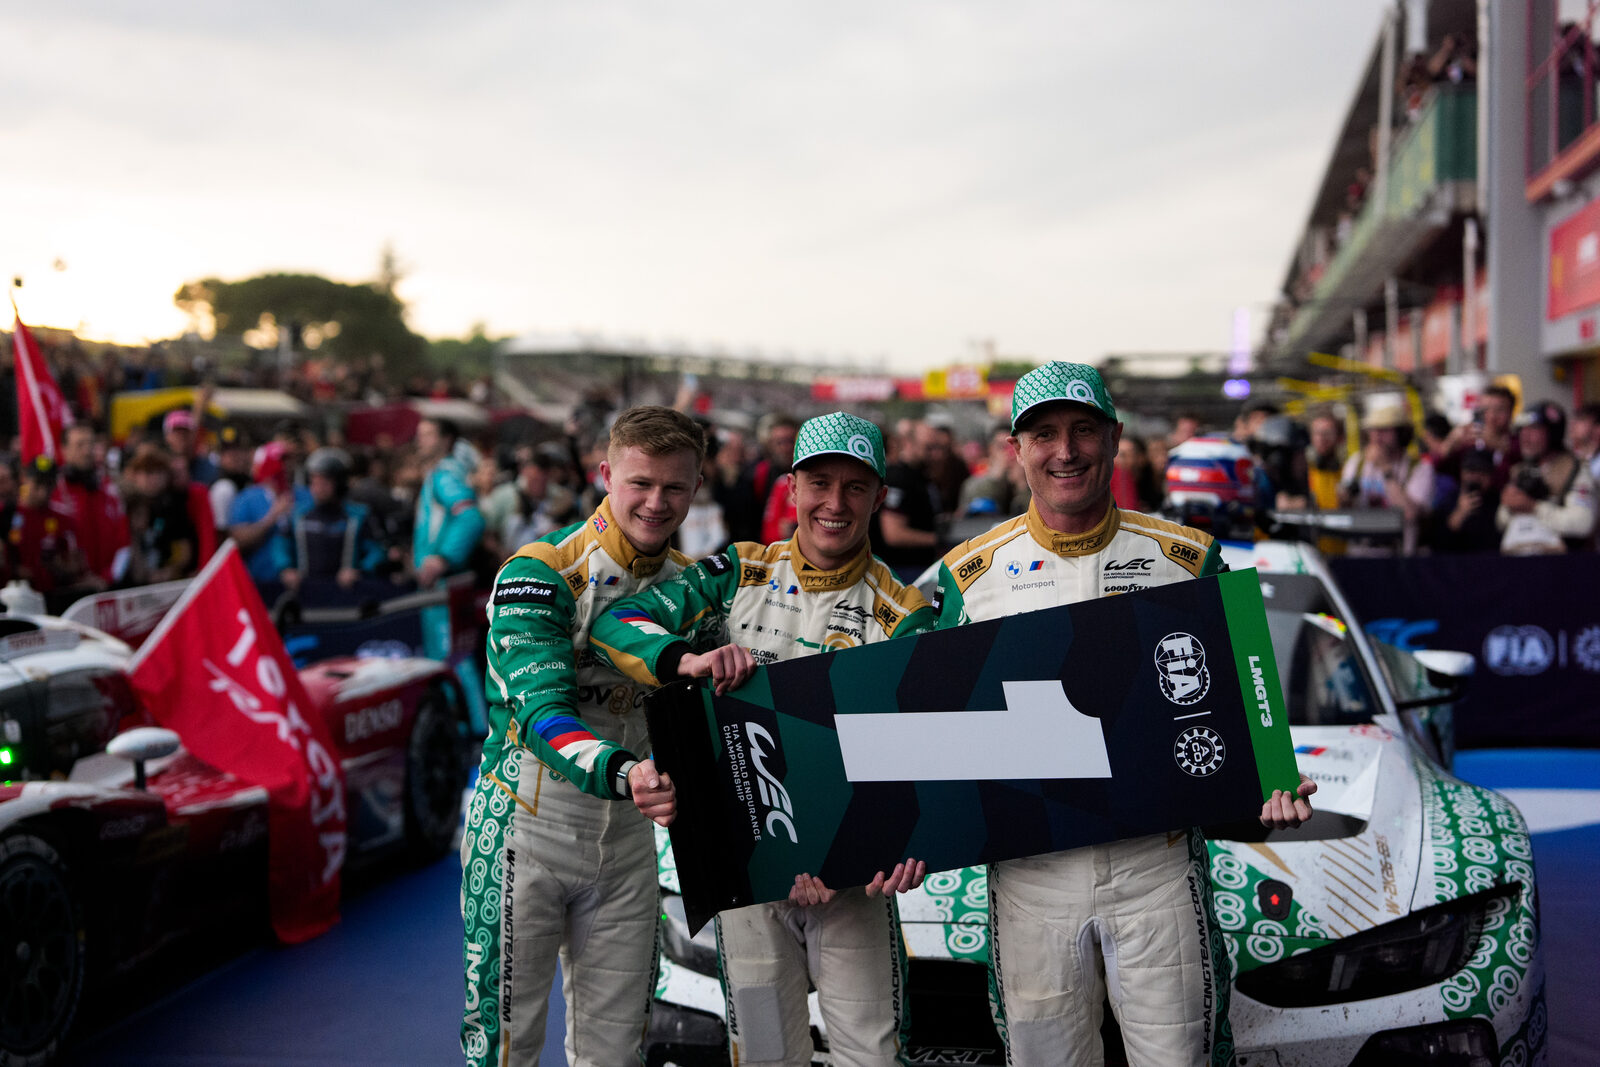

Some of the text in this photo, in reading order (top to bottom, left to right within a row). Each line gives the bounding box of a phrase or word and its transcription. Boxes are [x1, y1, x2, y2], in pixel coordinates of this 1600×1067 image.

[1171, 545, 1199, 561] OMP
[744, 569, 766, 580] OMP
[959, 558, 984, 578] OMP
[1104, 558, 1156, 571] WEC
[497, 585, 553, 598] GOODYEAR
[569, 573, 586, 591] OMP
[1011, 580, 1056, 593] Motorsport
[1104, 584, 1153, 592] GOODYEA
[765, 598, 803, 614] Motorspor
[878, 606, 897, 624] OMP
[750, 648, 778, 661] GLOBAL
[1488, 634, 1546, 668] FIA
[1162, 635, 1201, 700] FIA
[1248, 656, 1273, 728] LMGT3
[344, 698, 404, 744] DENSO
[833, 680, 1112, 783] 1
[723, 725, 745, 802] CHAMPIONSHIP
[731, 723, 762, 841] FIA WORLD ENDURANCE
[745, 721, 799, 844] WEC
[502, 848, 516, 1022] W-RACINGTEAM.COM
[1188, 876, 1211, 1054] W-RACINGTEAM.COM
